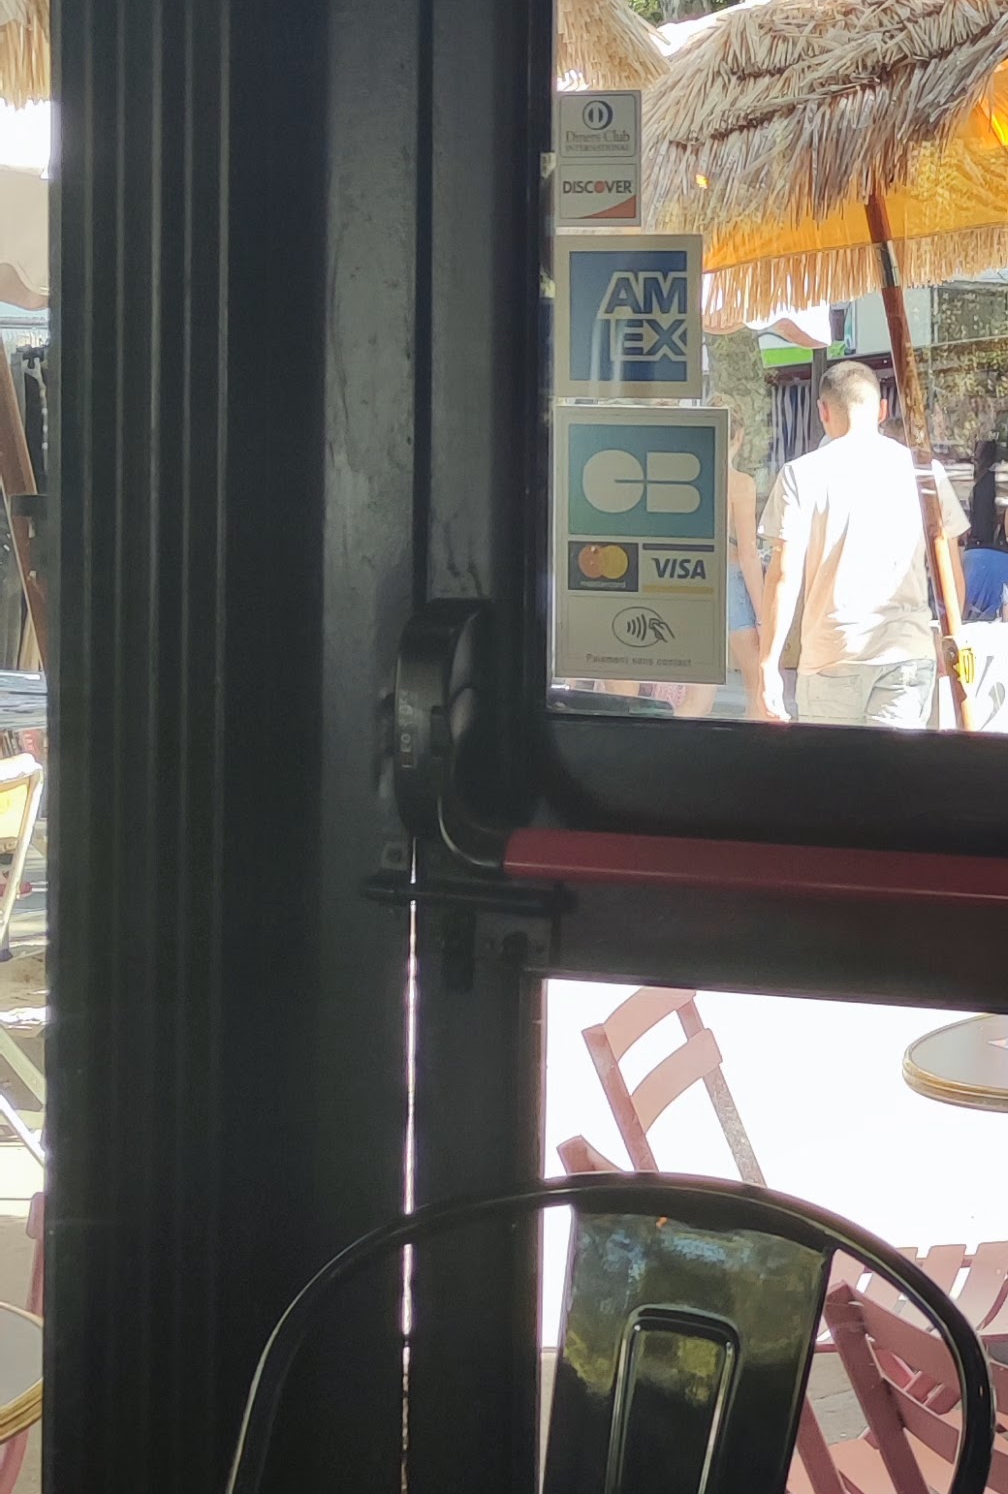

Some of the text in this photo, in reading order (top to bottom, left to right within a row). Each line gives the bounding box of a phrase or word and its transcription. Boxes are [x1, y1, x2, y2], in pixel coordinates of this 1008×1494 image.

[603, 129, 630, 143] Club
[562, 179, 633, 194] DISCOVER
[602, 274, 688, 315] AM
[651, 557, 707, 580] VISA
